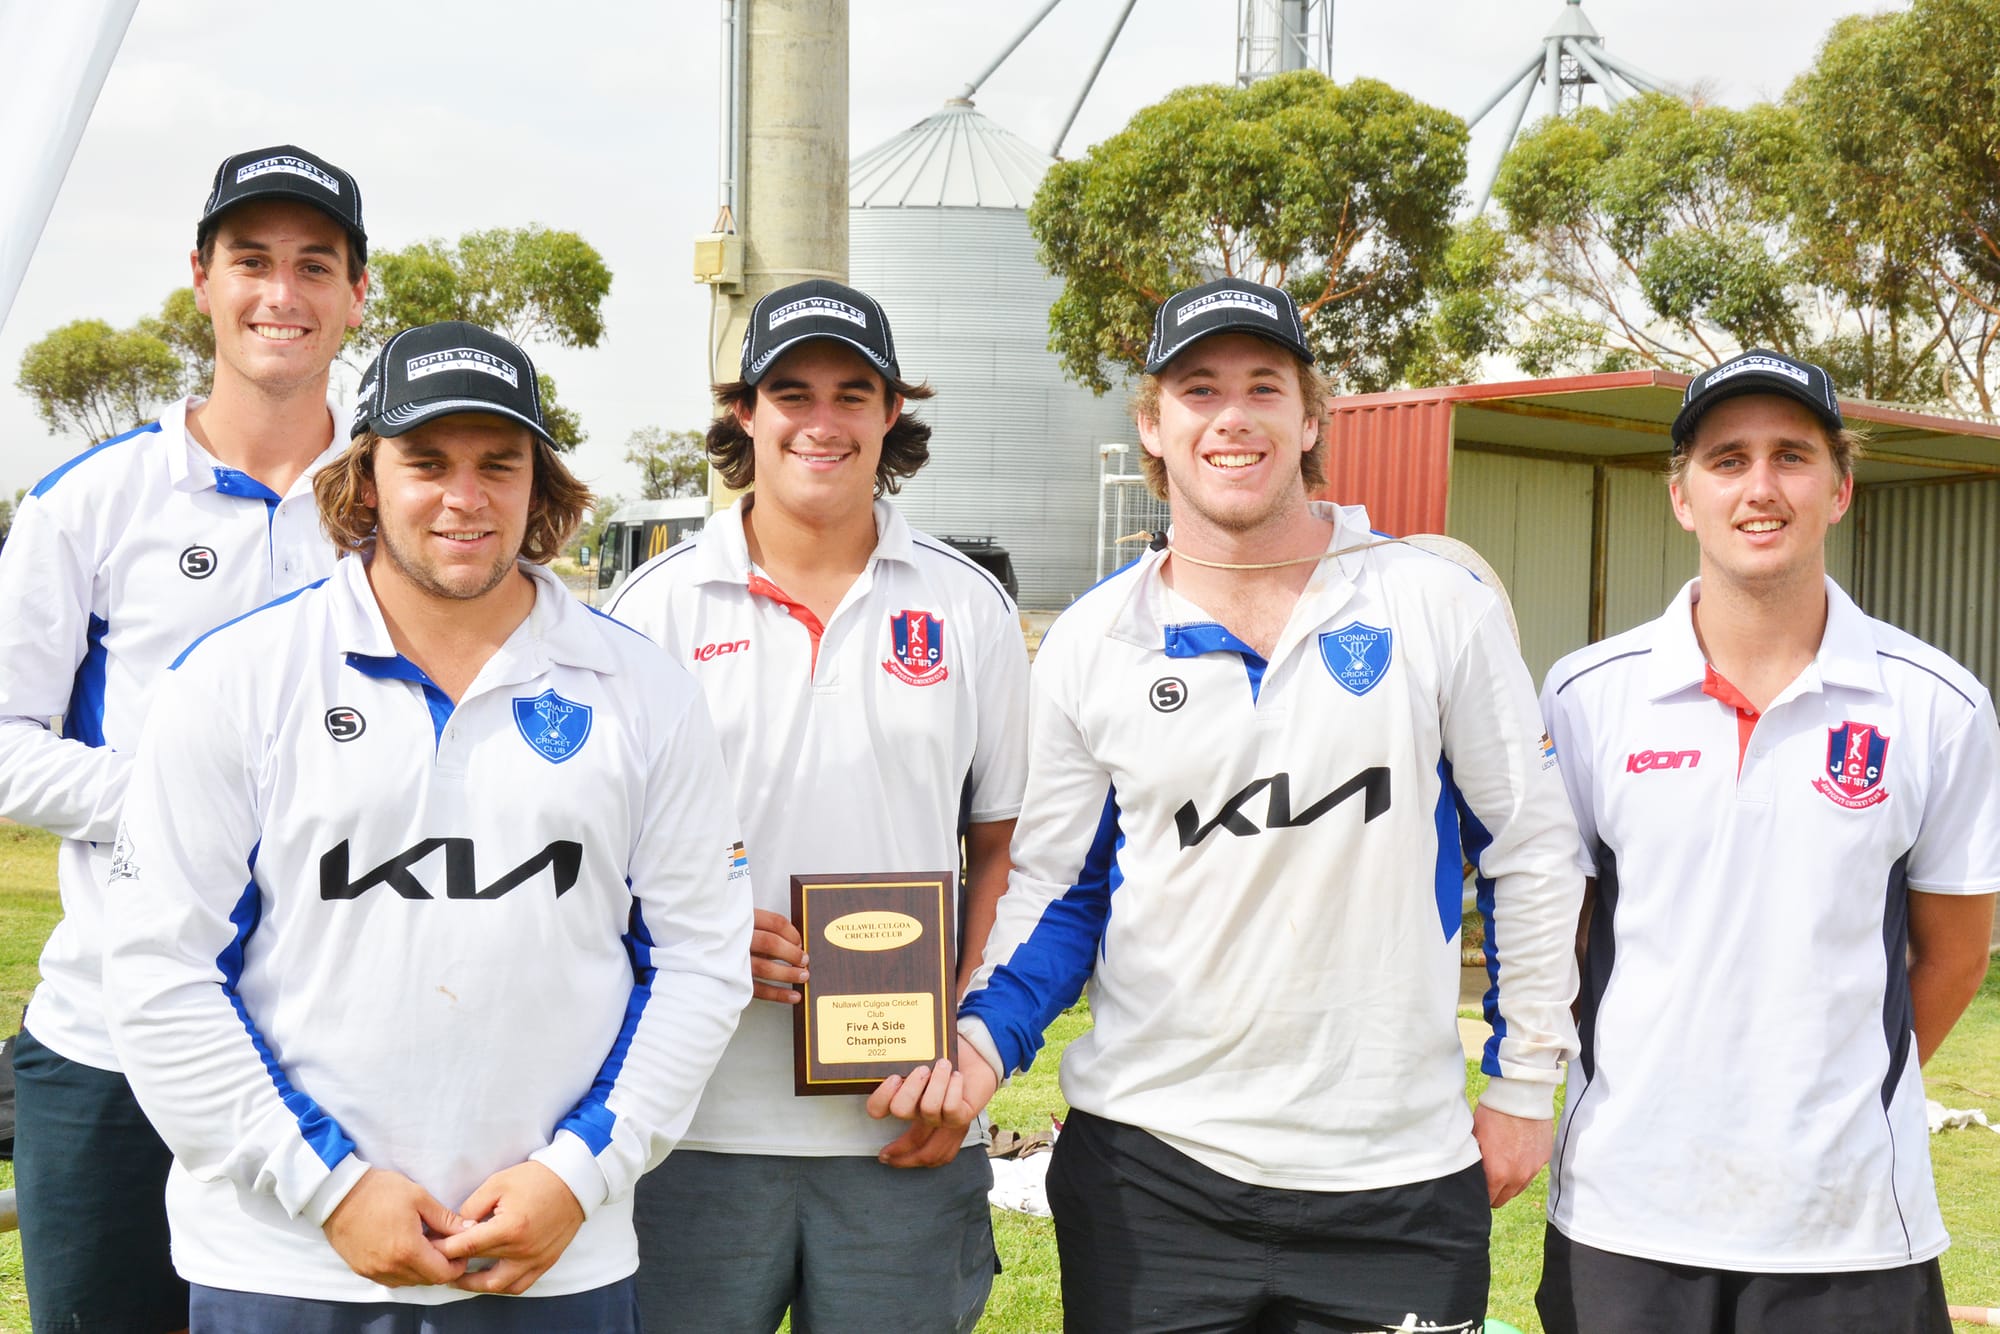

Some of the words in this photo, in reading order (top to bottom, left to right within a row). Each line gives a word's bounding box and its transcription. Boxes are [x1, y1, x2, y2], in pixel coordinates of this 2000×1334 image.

[239, 158, 279, 176] north
[283, 158, 319, 176] west
[1180, 295, 1215, 316] north
[1220, 292, 1256, 303] west
[772, 301, 806, 320] north
[811, 299, 845, 311] west
[409, 351, 454, 370] north
[458, 351, 498, 366] west
[1749, 357, 1786, 370] west
[1338, 633, 1378, 643] DONALD
[903, 657, 916, 666] EST
[1340, 670, 1375, 679] CRICKET
[1349, 678, 1370, 686] CLUB
[534, 700, 574, 713] DONALD
[535, 737, 571, 748] CRICKET
[543, 745, 566, 754] CLUB
[1837, 774, 1853, 785] EST
[836, 923, 877, 932] NULLAWIL
[878, 922, 911, 930] CULGOA
[845, 931, 880, 940] CRICKET
[881, 930, 903, 938] CLUB
[832, 1000, 861, 1009] Nullawil
[863, 1000, 890, 1010] Culgoa
[891, 999, 918, 1007] Cricket
[866, 1010, 885, 1018] Club
[846, 1022, 869, 1032] Five
[871, 1022, 880, 1031] A
[882, 1021, 906, 1031] Side
[846, 1036, 907, 1046] Champions
[867, 1048, 887, 1057] 2022
